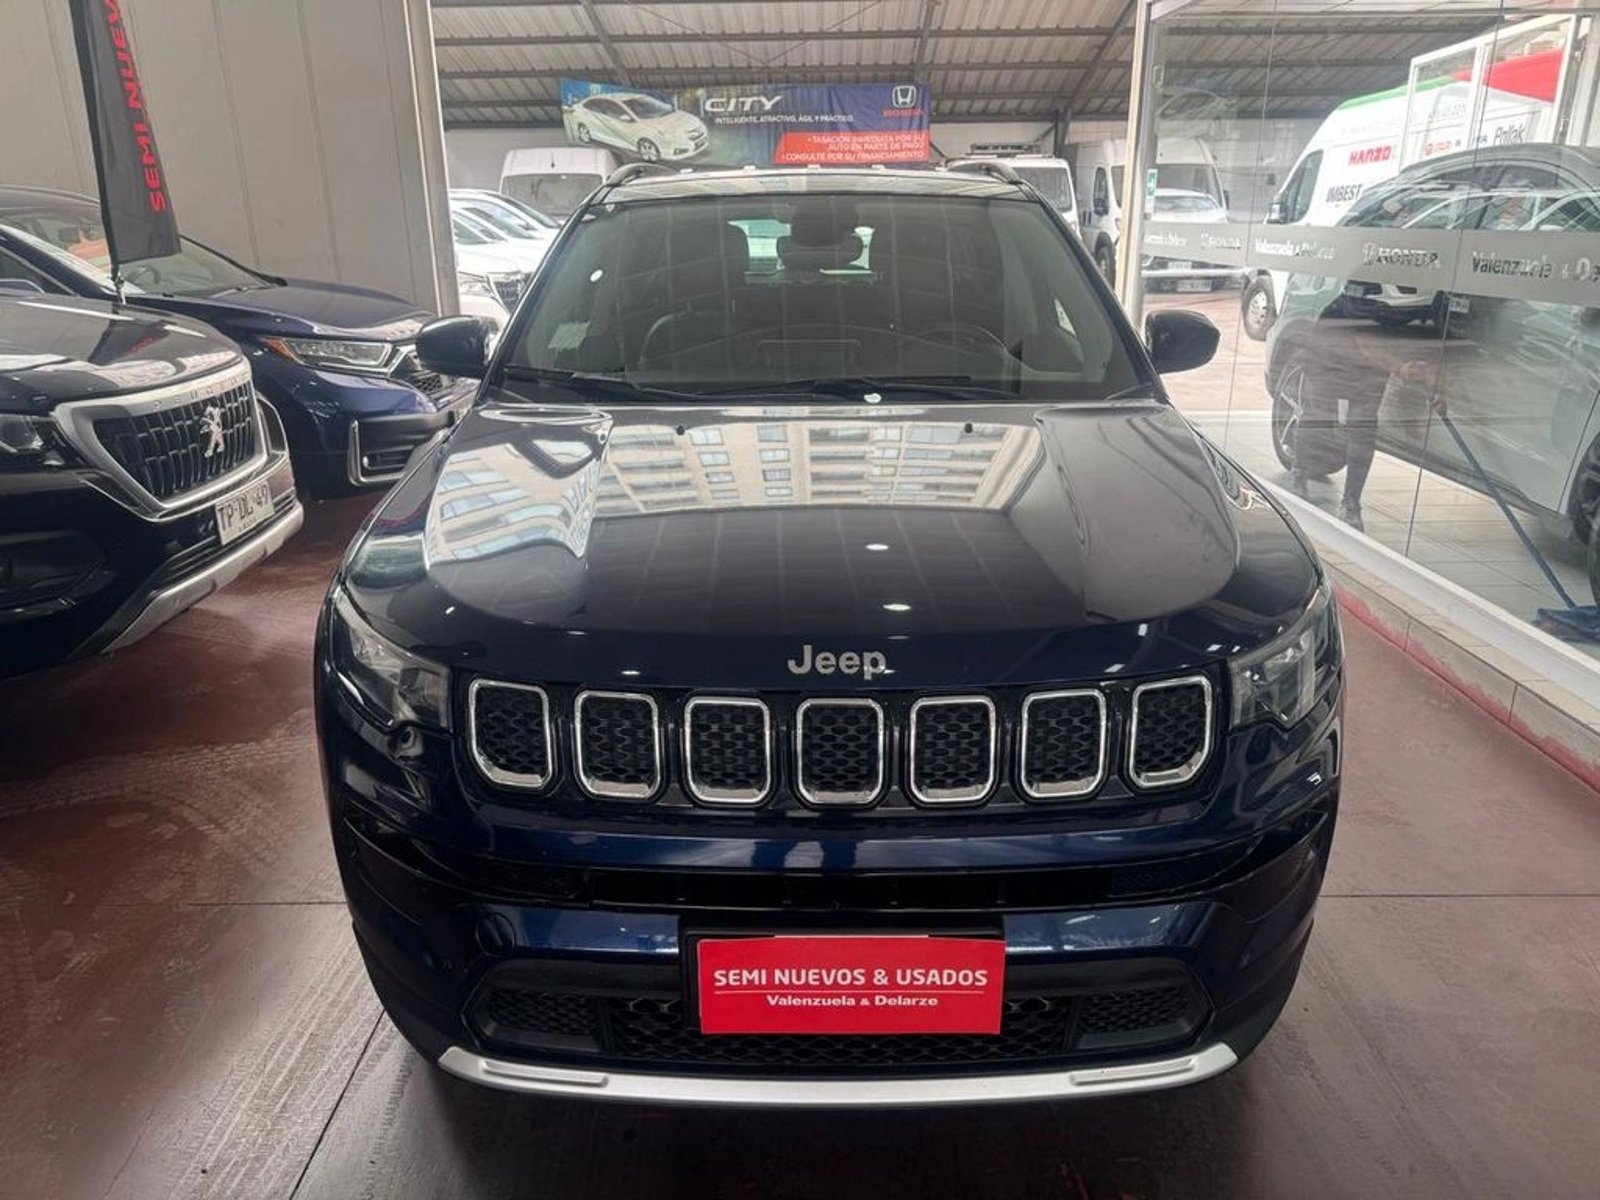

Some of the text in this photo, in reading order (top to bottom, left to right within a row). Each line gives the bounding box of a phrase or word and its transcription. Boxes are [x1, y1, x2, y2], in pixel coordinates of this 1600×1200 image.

[705, 95, 783, 112] CITY
[133, 121, 165, 213] SEMI
[787, 644, 887, 680] Jeep
[713, 968, 989, 986] SEMI NUEVOS & USADOS
[767, 994, 939, 1007] Valenzuela & Delarze
